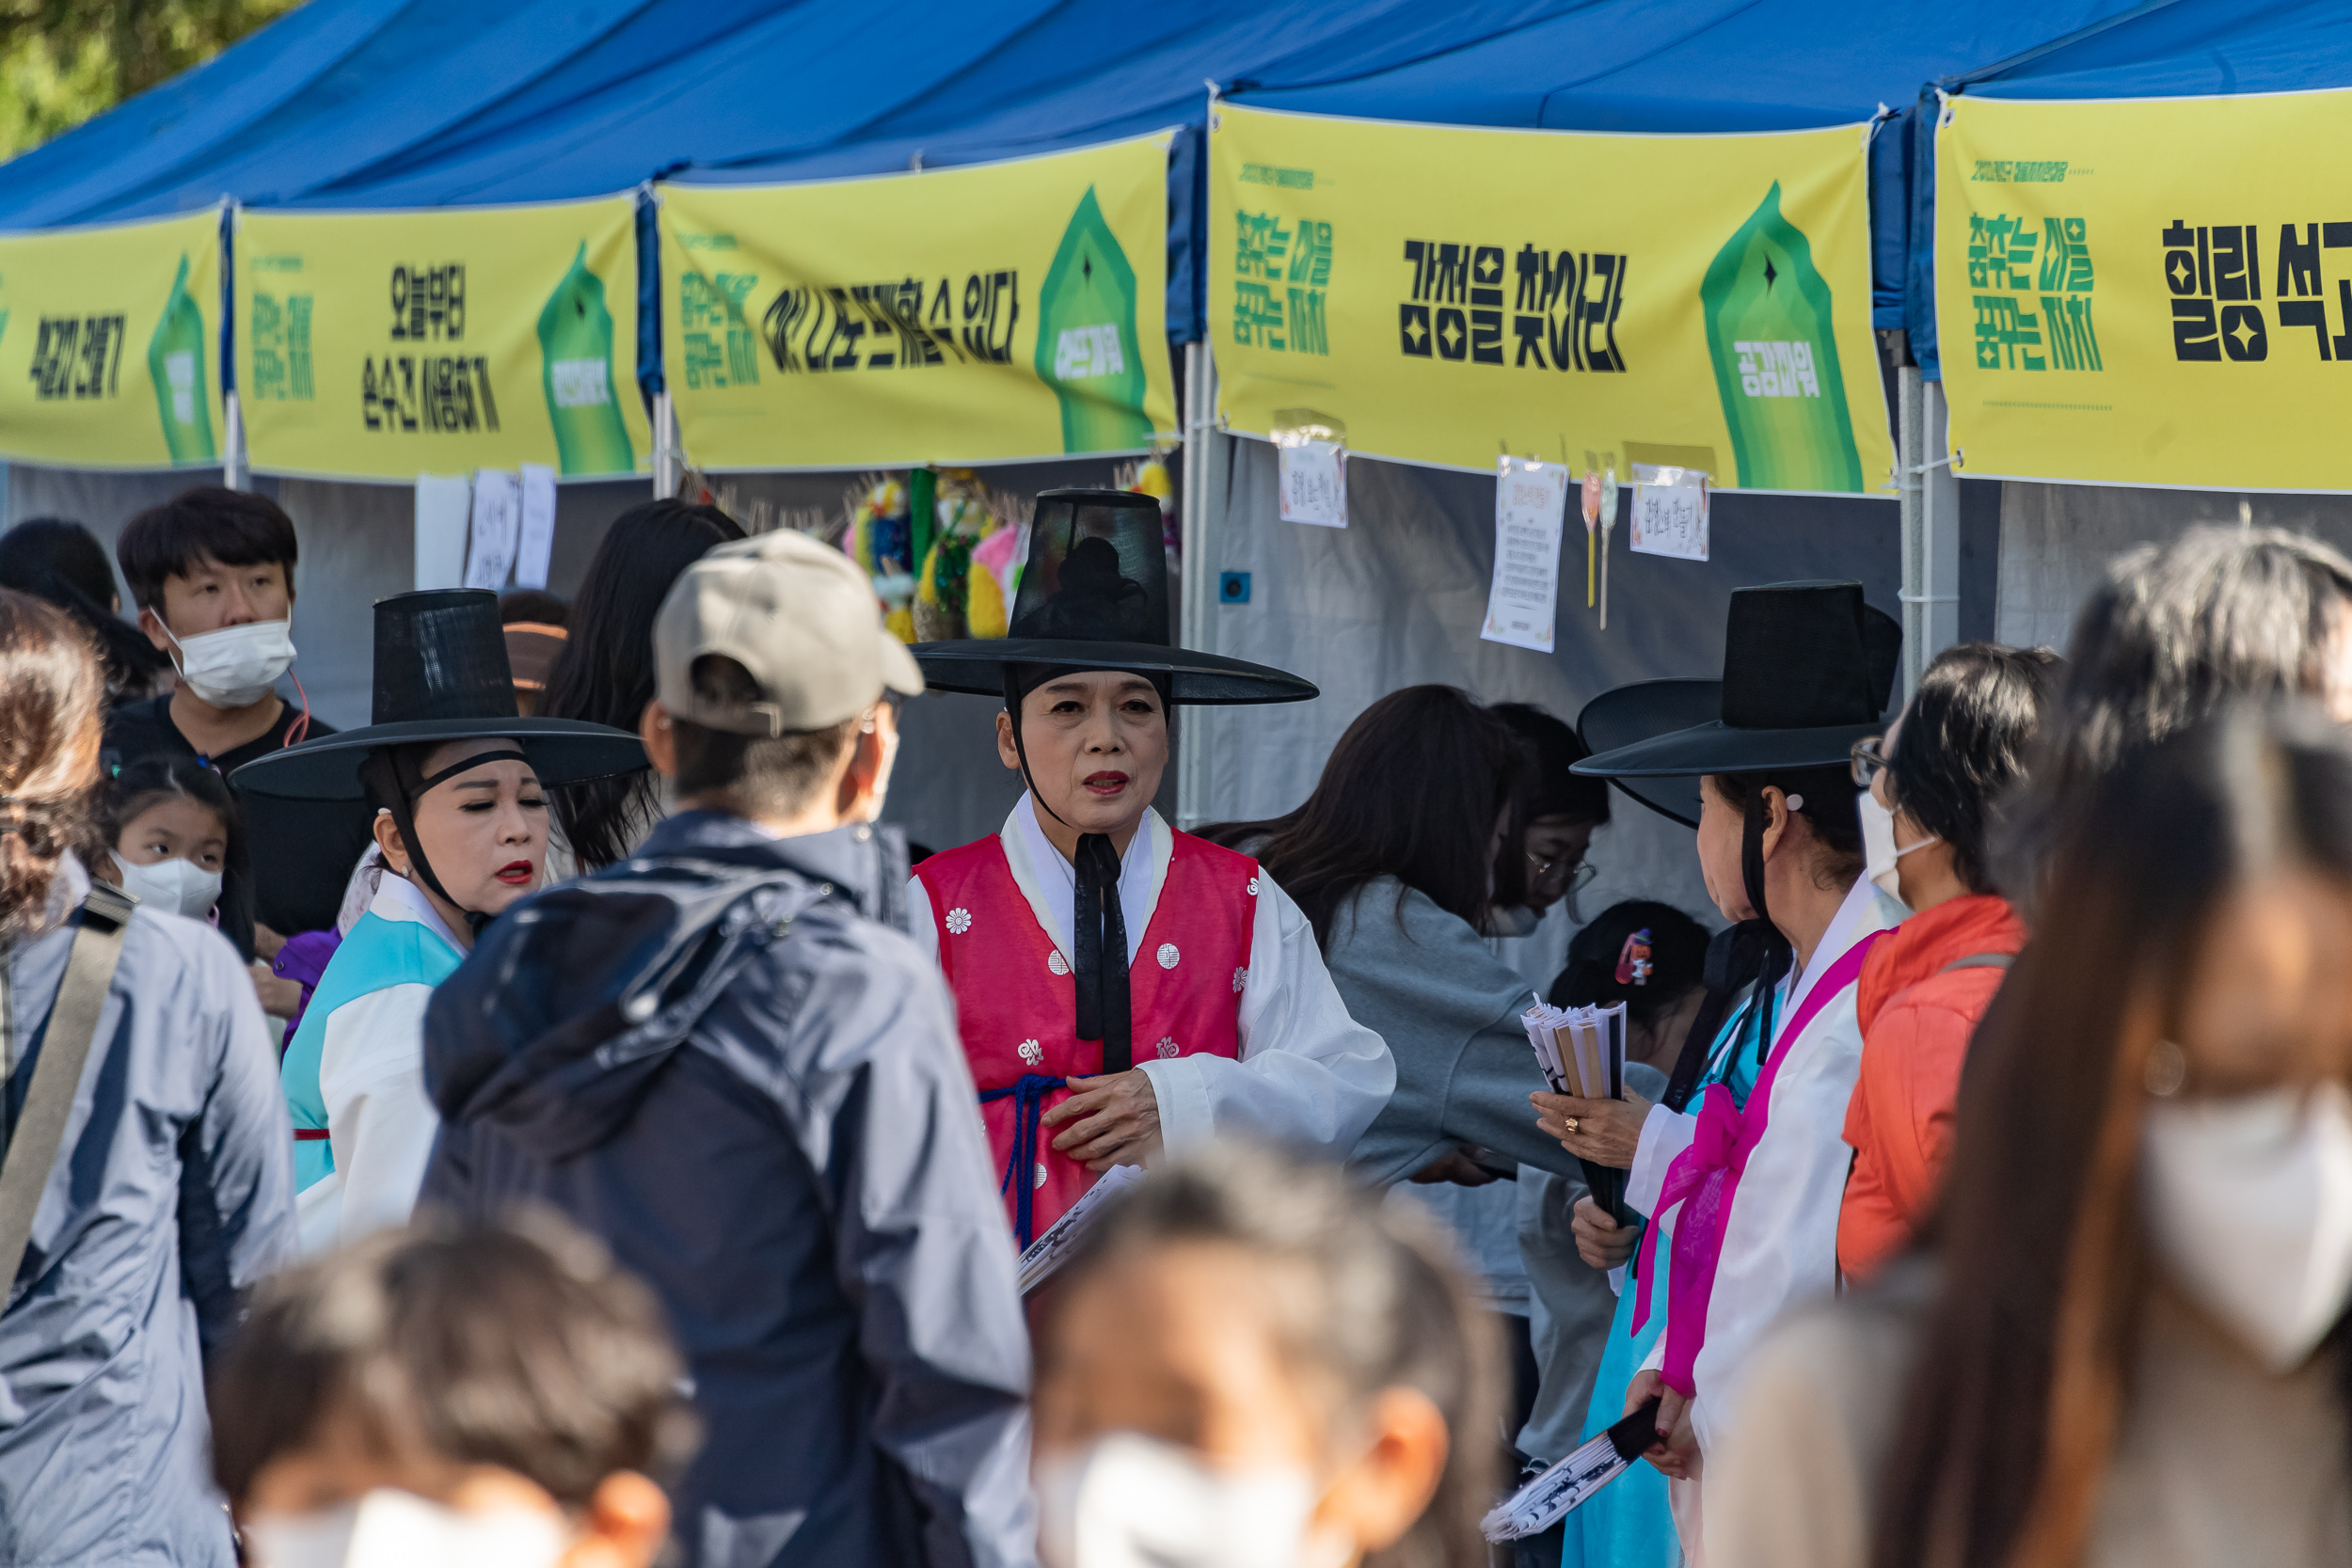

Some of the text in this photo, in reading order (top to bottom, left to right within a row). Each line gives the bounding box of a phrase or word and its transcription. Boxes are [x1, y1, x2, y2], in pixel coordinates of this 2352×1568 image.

[1968, 212, 2095, 293] 춤추는 마을
[2162, 219, 2268, 361] 힐링
[391, 264, 467, 341] 오늘부터
[961, 269, 1020, 367] 있다
[1398, 239, 1628, 373] 감정을 찾아라
[1971, 293, 2105, 372] 꿈꾸는 자치
[362, 355, 420, 433] 손수건
[1733, 341, 1821, 398] 공감파워
